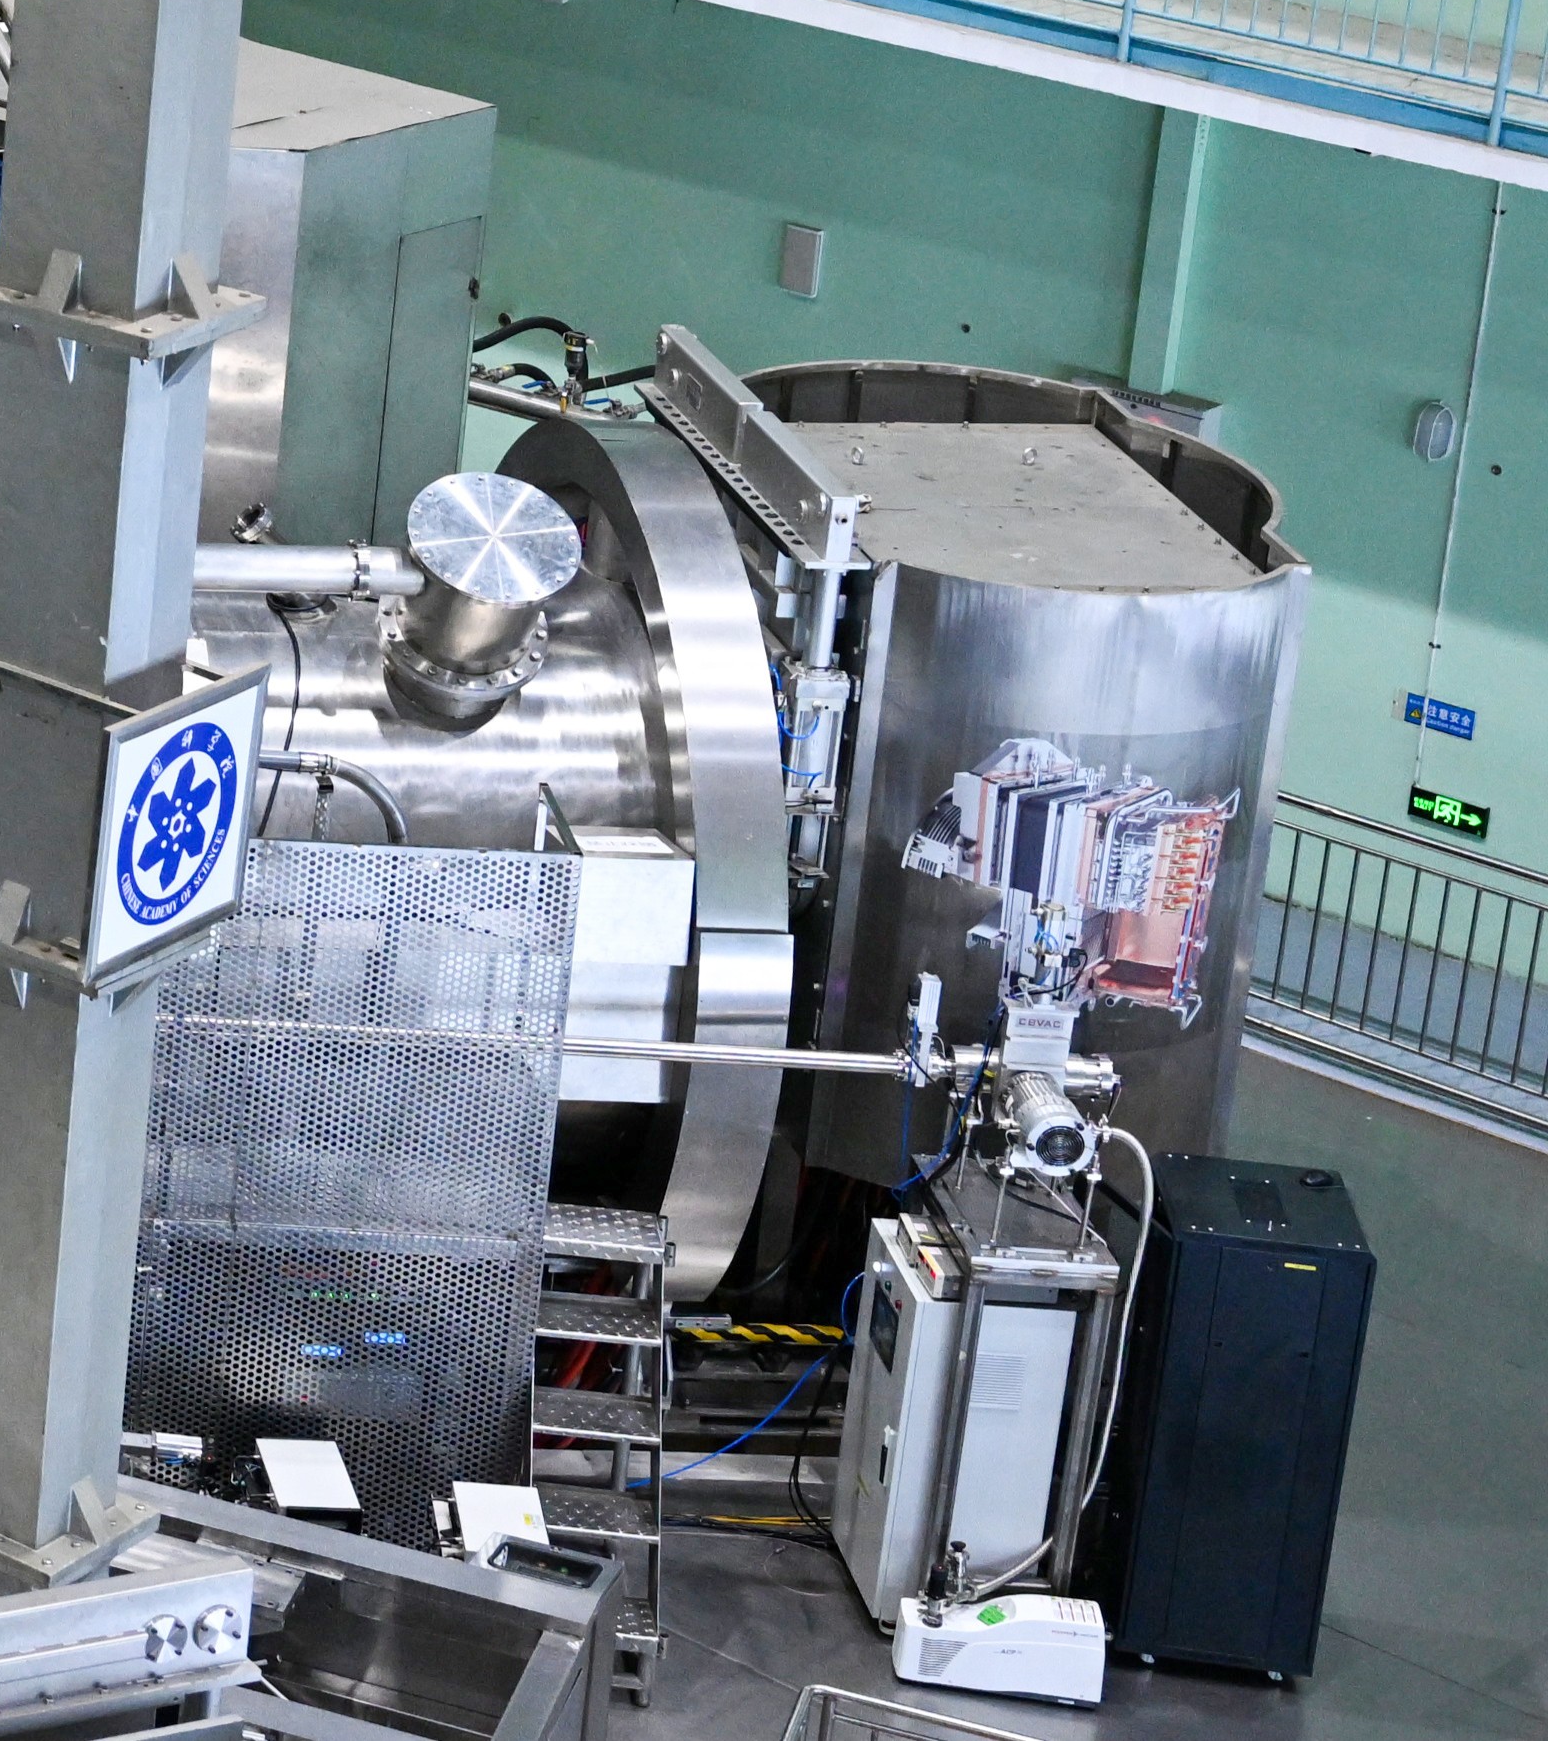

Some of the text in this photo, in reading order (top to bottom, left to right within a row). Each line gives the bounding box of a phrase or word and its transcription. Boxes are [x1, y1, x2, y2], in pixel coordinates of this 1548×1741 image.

[120, 828, 226, 920] CHINESE ACADEMY OF SCIENCES
